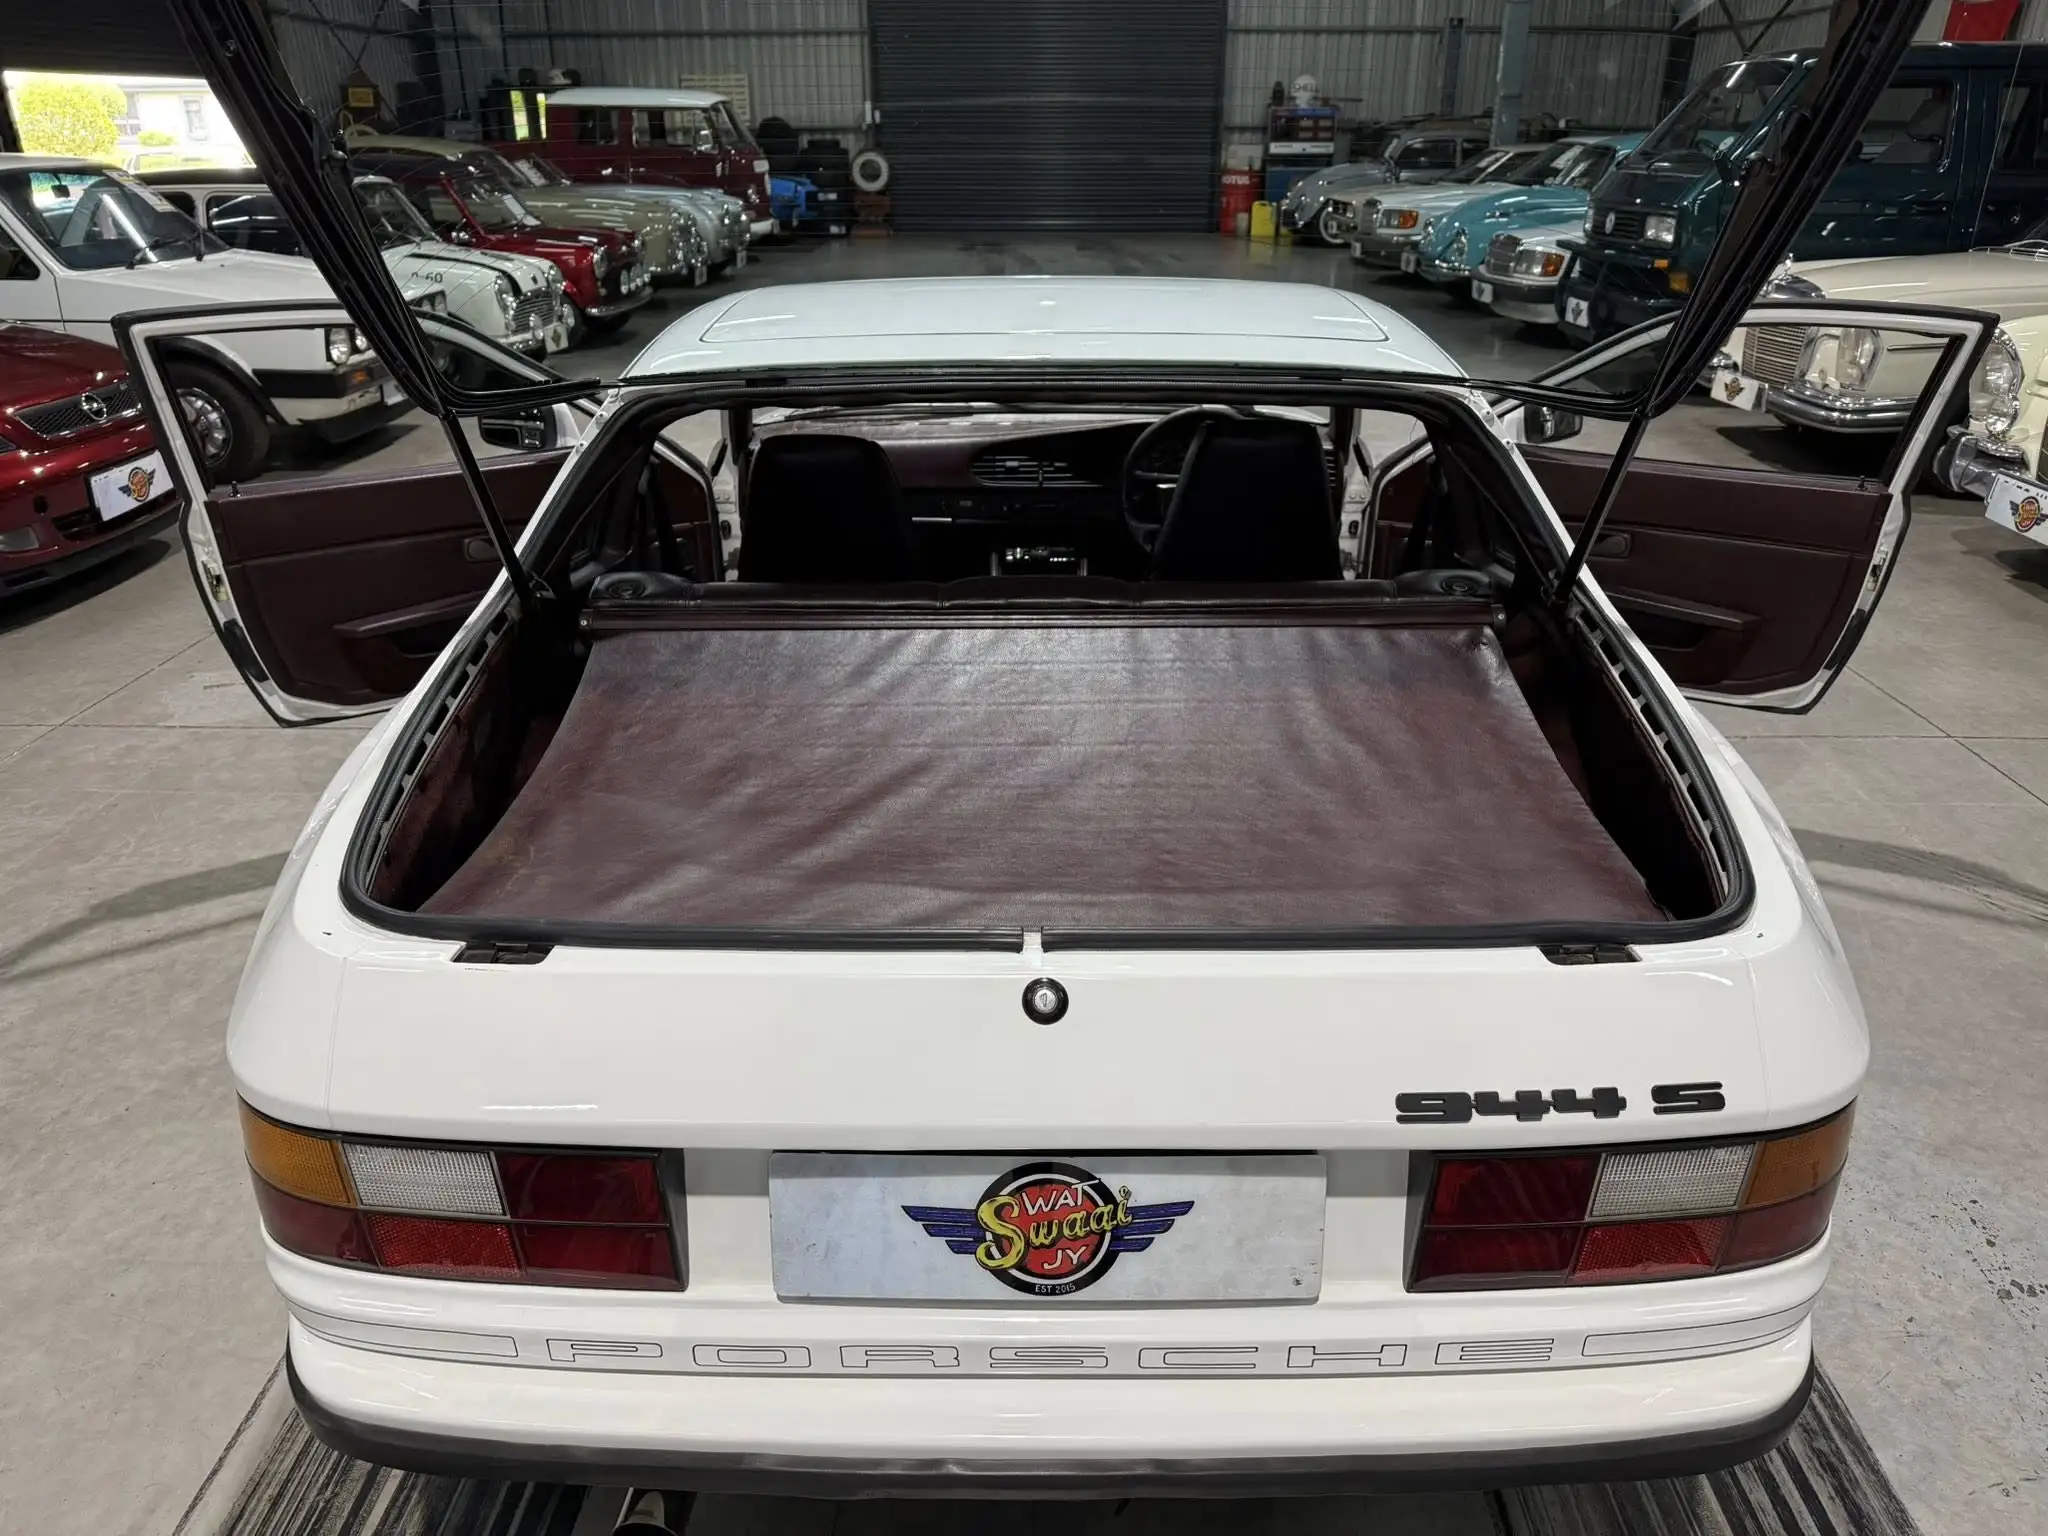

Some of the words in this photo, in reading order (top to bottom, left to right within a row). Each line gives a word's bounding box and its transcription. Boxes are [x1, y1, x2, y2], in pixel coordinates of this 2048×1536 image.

[1395, 1087, 1627, 1124] 944
[1651, 1081, 1726, 1115] S
[1021, 1179, 1100, 1216] WAT
[975, 1185, 1133, 1270] Swaai
[1042, 1246, 1088, 1270] JY
[1035, 1283, 1053, 1293] EST
[1055, 1283, 1076, 1293] 2015
[546, 1338, 1554, 1369] PORSCHE
